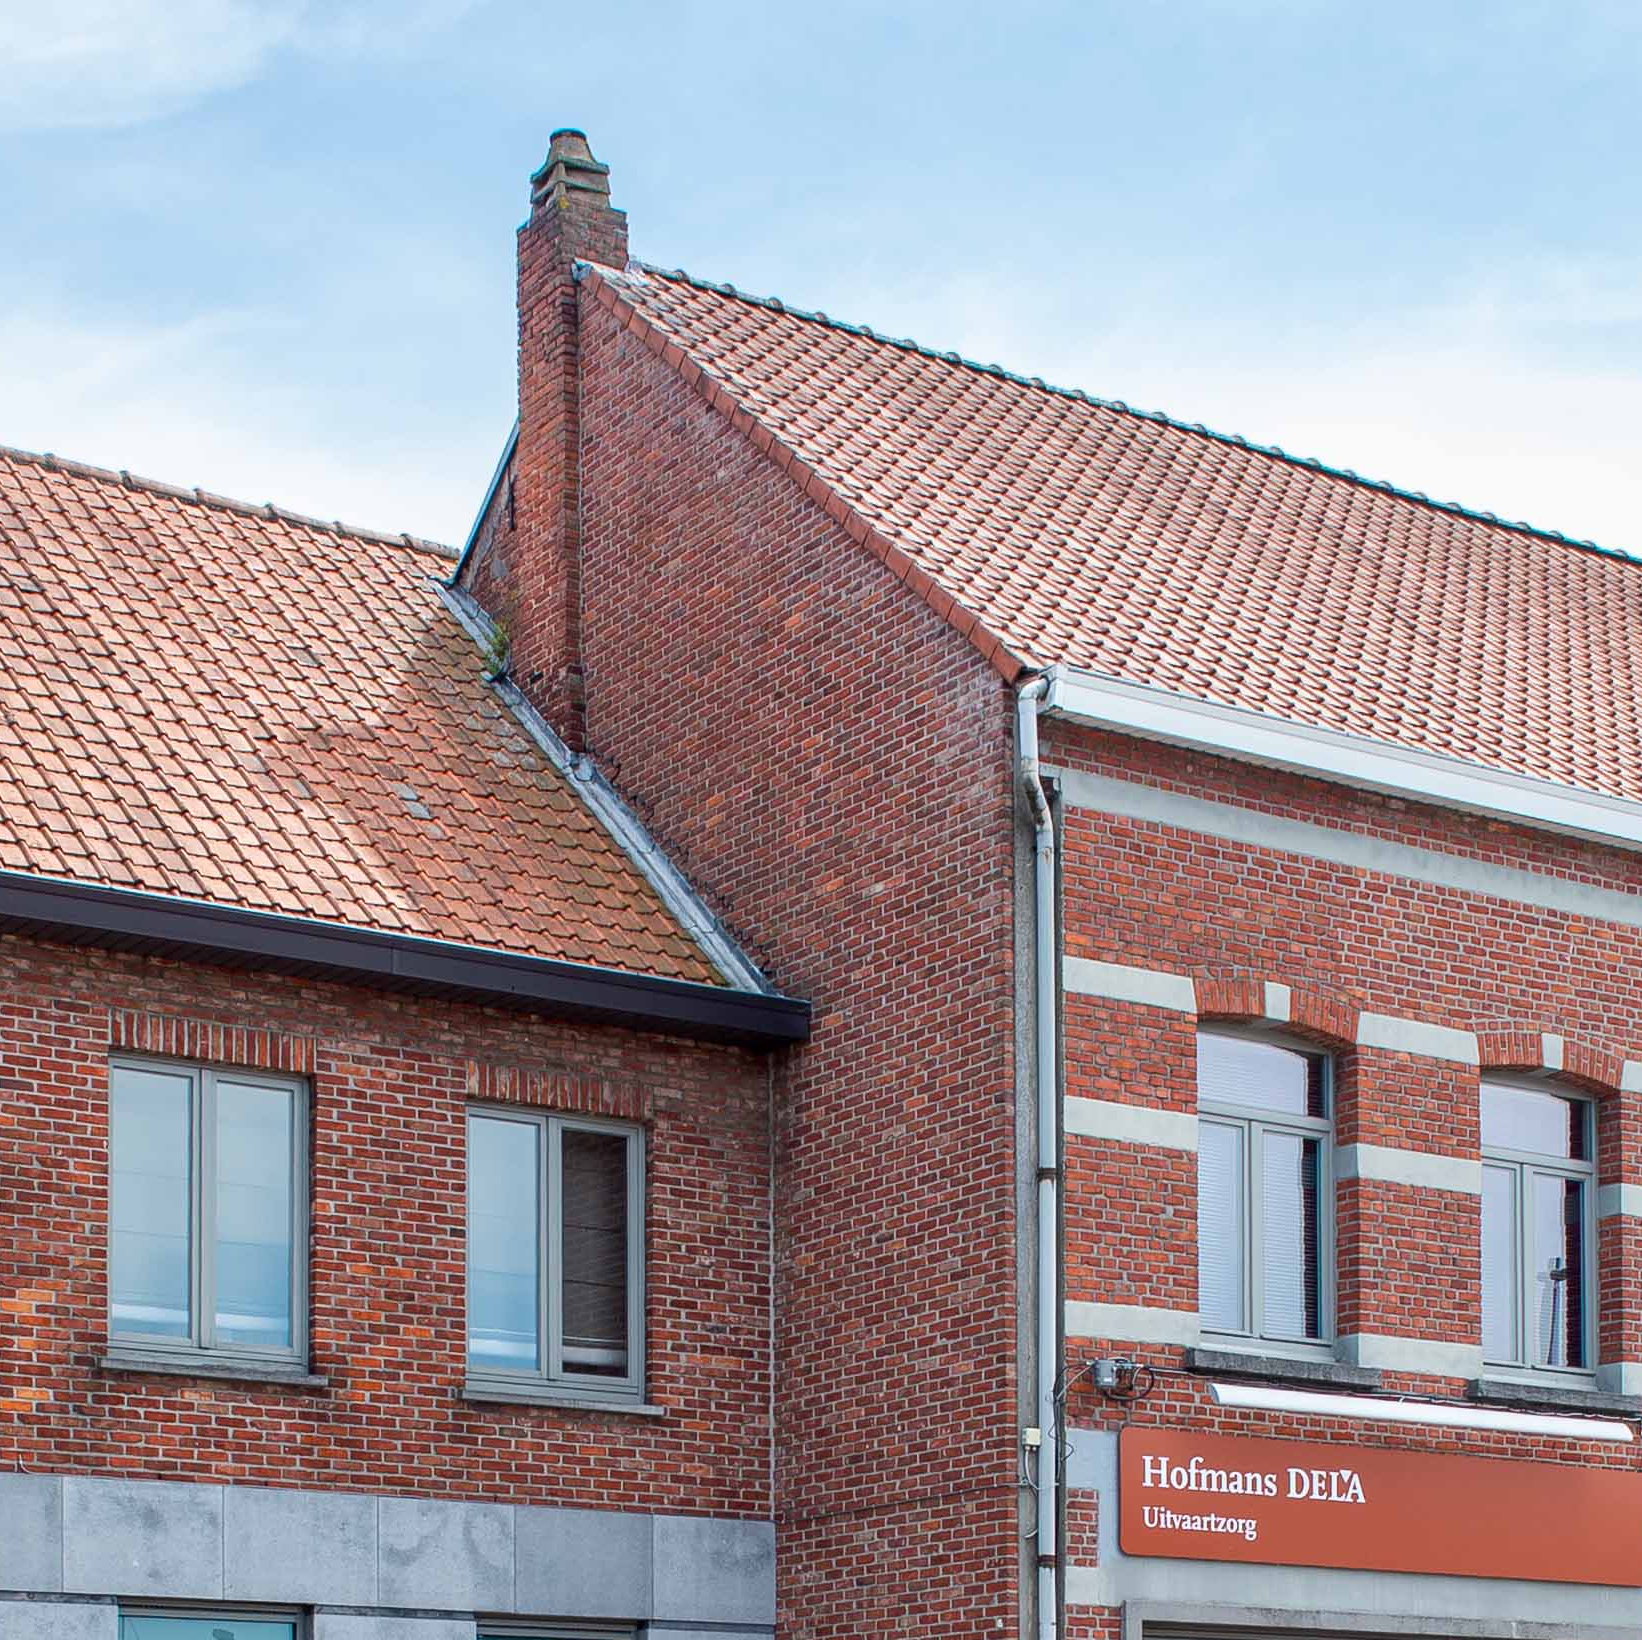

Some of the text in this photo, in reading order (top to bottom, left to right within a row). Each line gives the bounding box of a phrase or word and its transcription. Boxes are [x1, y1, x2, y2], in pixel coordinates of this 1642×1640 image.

[1142, 1455, 1366, 1503] Hofmans DELA
[1142, 1506, 1258, 1541] Uitvaartzorg
